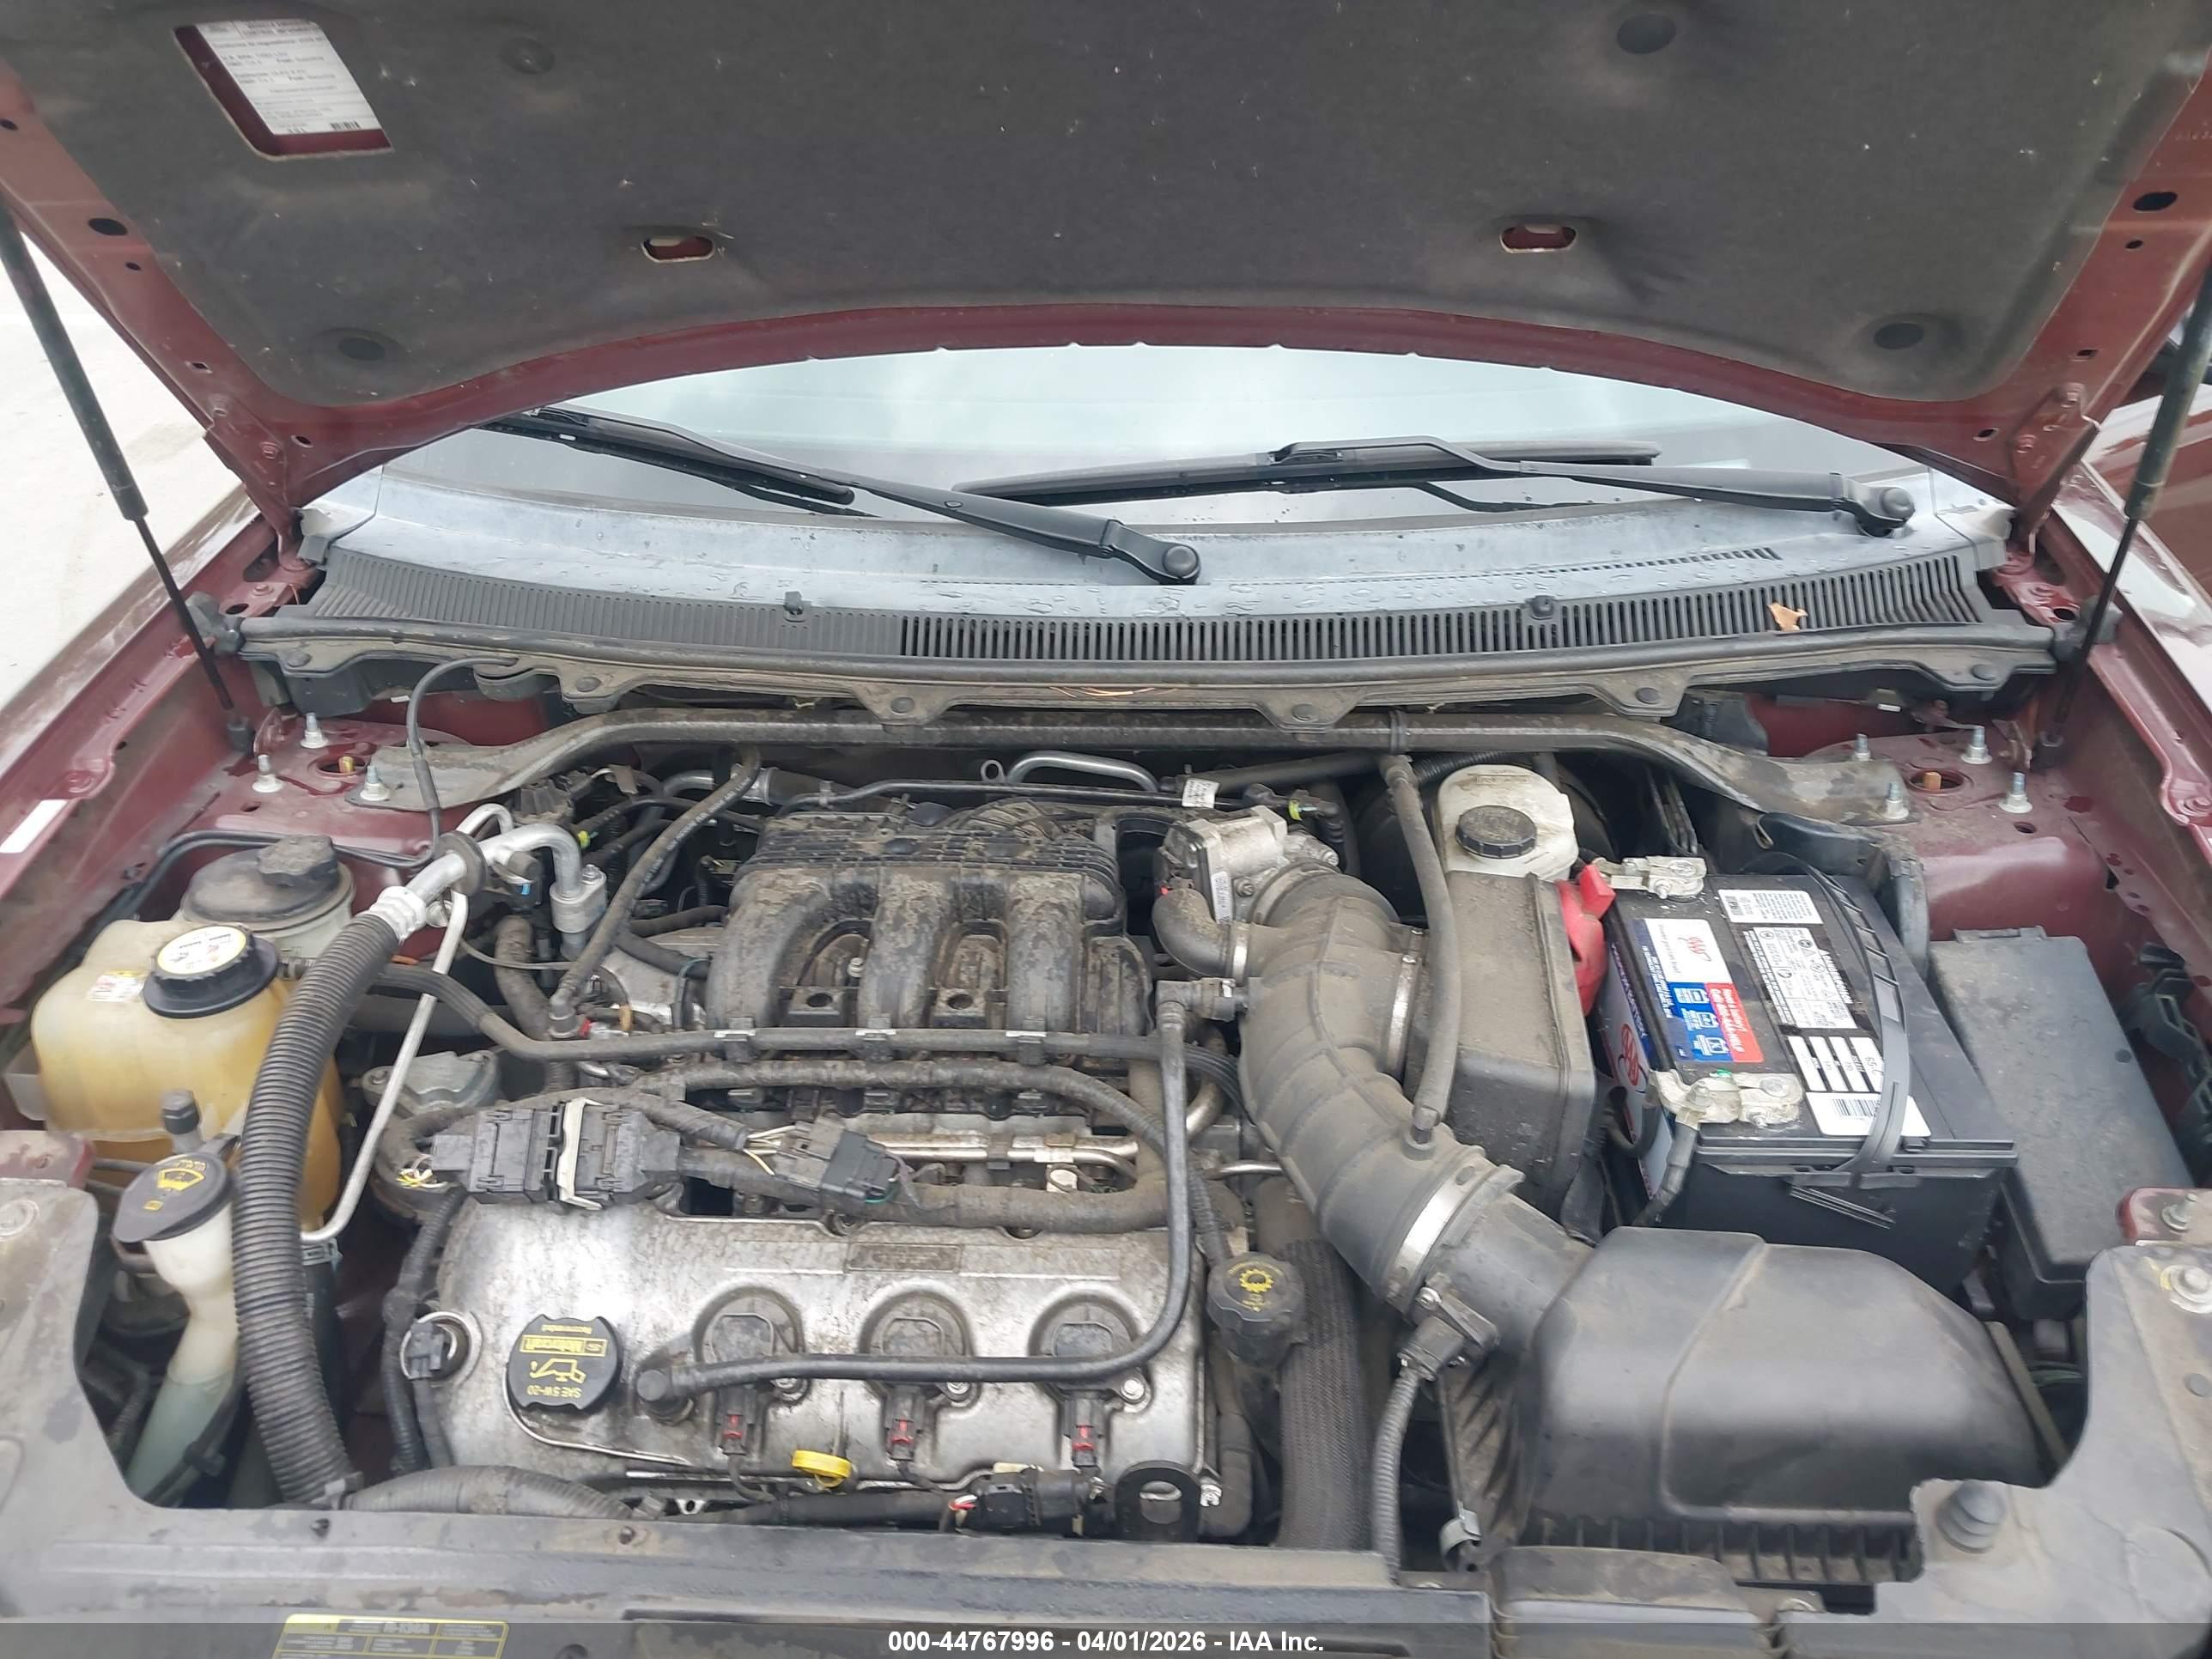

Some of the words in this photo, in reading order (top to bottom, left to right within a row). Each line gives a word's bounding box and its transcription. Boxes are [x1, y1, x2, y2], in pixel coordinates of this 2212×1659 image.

[523, 1338, 584, 1352] Motorcraft
[526, 1384, 561, 1396] 5W-20
[562, 1387, 582, 1399] SAE
